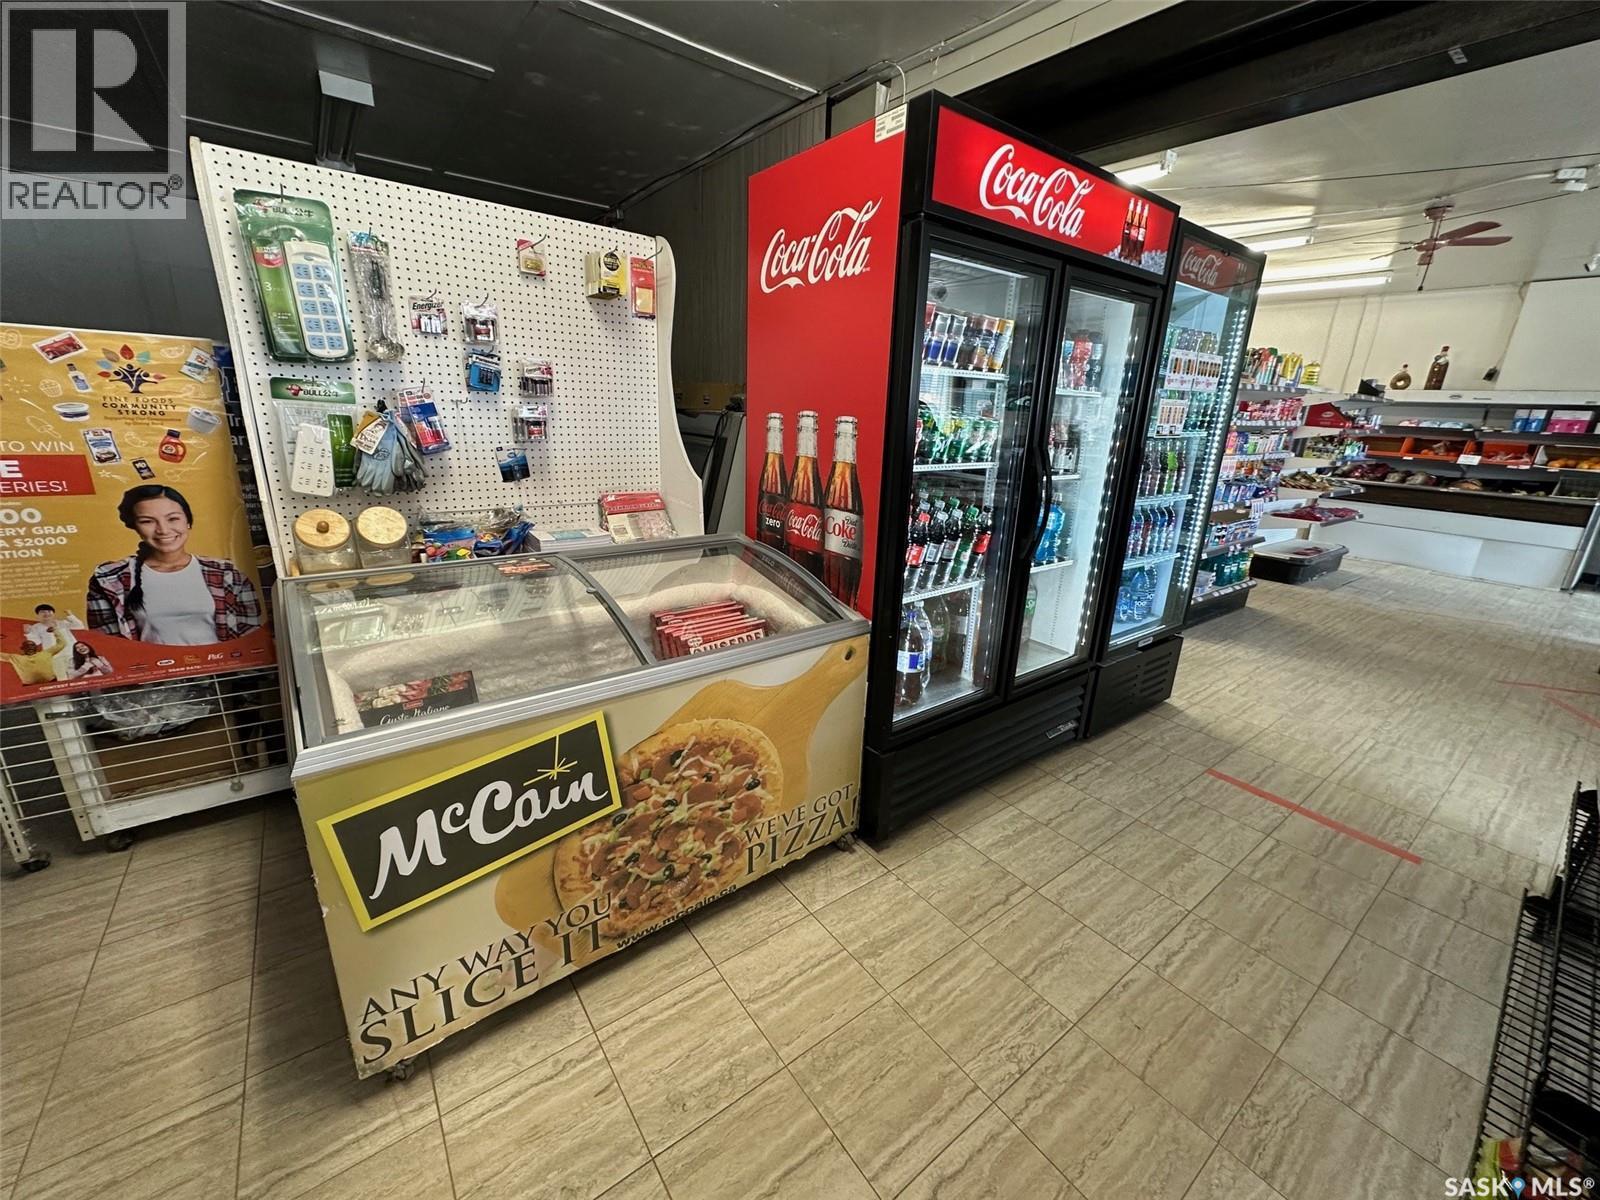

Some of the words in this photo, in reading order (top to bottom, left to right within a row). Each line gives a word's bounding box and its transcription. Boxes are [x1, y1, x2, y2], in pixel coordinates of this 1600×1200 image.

[979, 144, 1095, 238] Coca-Cola
[761, 196, 883, 293] Coca-Cola
[1180, 246, 1223, 286] Coca-Cola
[413, 302, 444, 311] Energizer
[102, 402, 177, 410] COMMUNITY
[31, 441, 75, 452] WIN
[0, 481, 69, 493] ERIES!
[31, 525, 78, 536] GRAB
[765, 517, 781, 529] zero
[786, 509, 823, 541] Coca-Cola
[825, 515, 857, 540] Coke
[14, 537, 67, 547] $2000
[745, 805, 805, 843] WE'VE
[813, 783, 853, 813] GOT
[369, 772, 608, 900] McCain
[746, 796, 859, 876] PIZZA!
[359, 963, 449, 1027] ANY
[457, 925, 535, 976] WAY
[545, 892, 612, 937] YOU
[360, 948, 539, 1065] SLICE
[560, 914, 611, 968] IT
